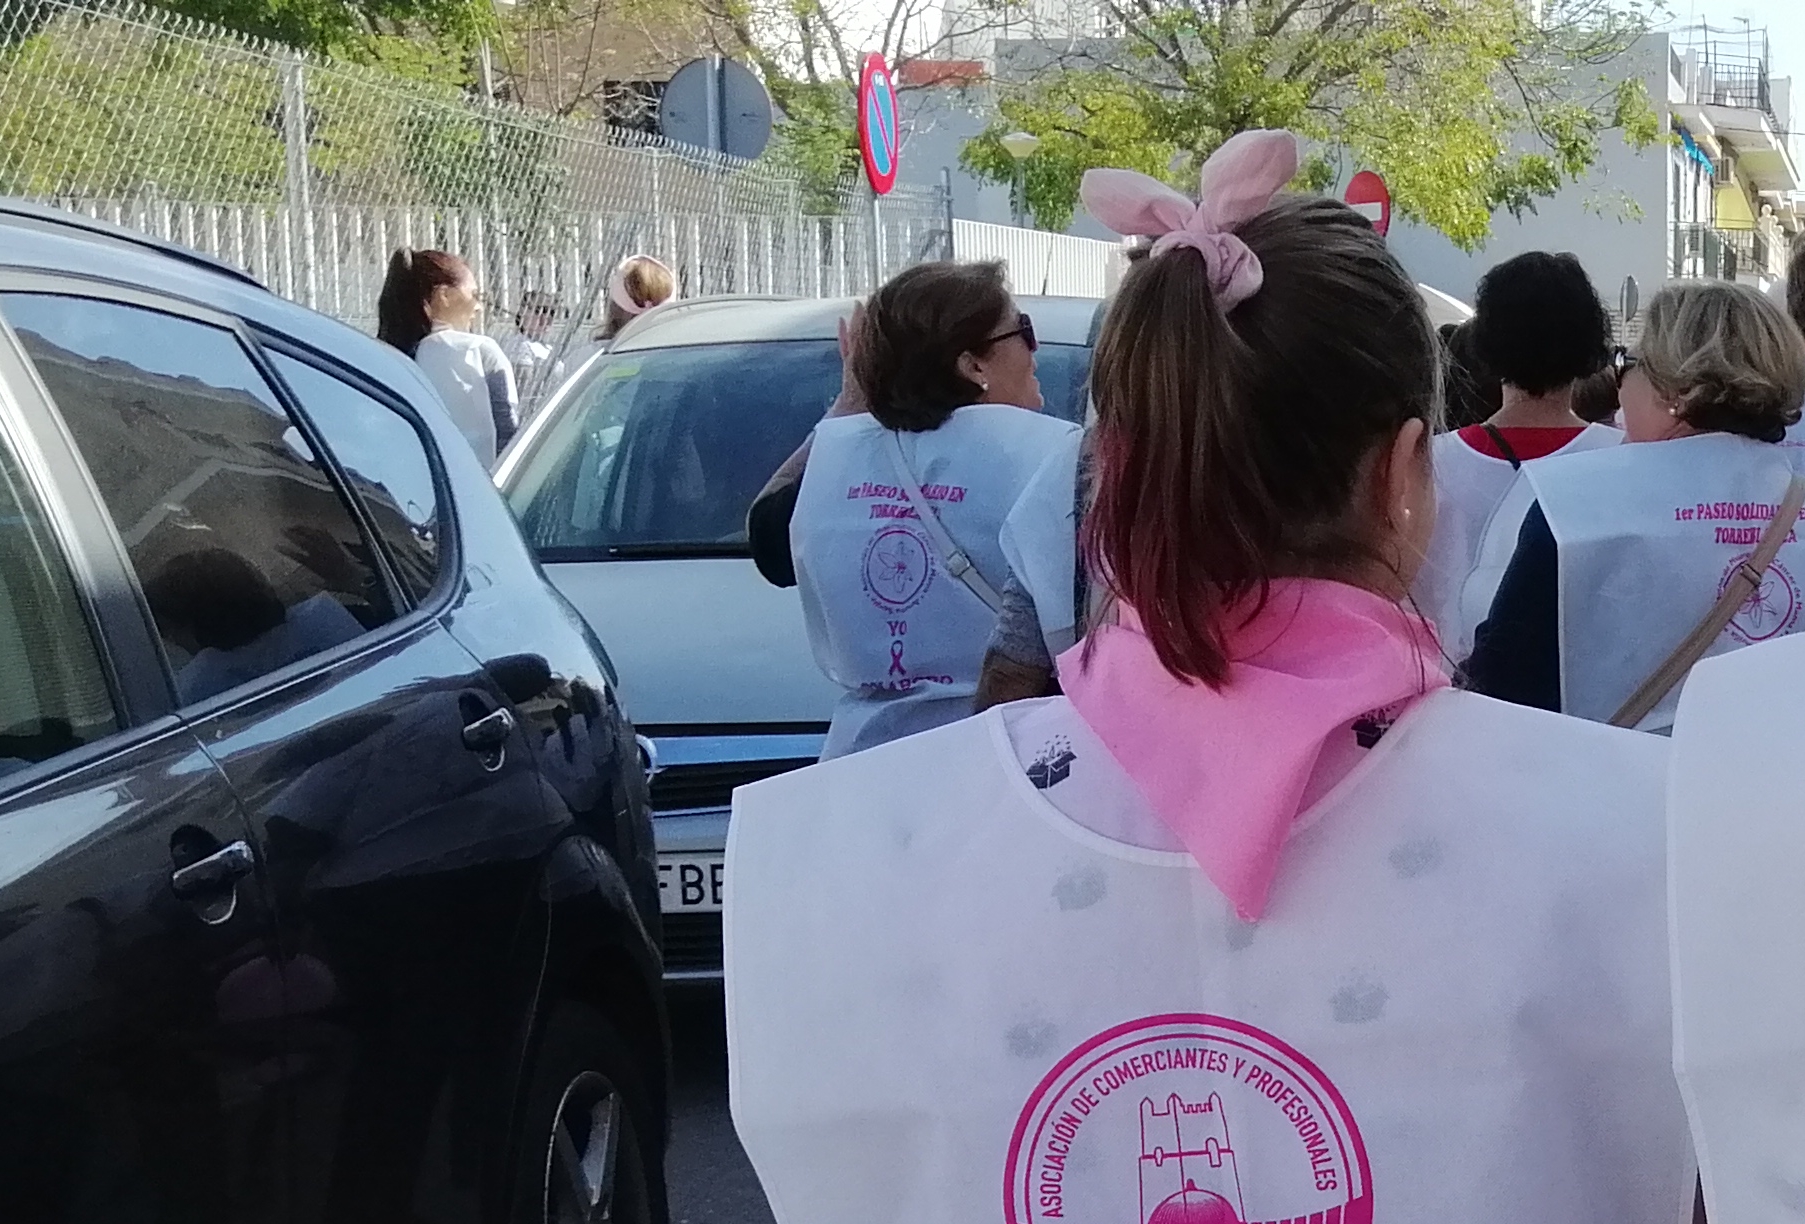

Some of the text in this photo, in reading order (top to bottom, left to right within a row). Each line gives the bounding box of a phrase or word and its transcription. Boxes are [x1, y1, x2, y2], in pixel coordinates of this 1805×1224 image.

[1675, 507, 1695, 521] 1er
[1696, 502, 1734, 520] PASEO
[1735, 502, 1780, 521] SOLIDA
[887, 620, 907, 637] YO
[1040, 1048, 1338, 1219] ASOCIACIÓN DE COMERCIANTES Y PROFESIONALES
